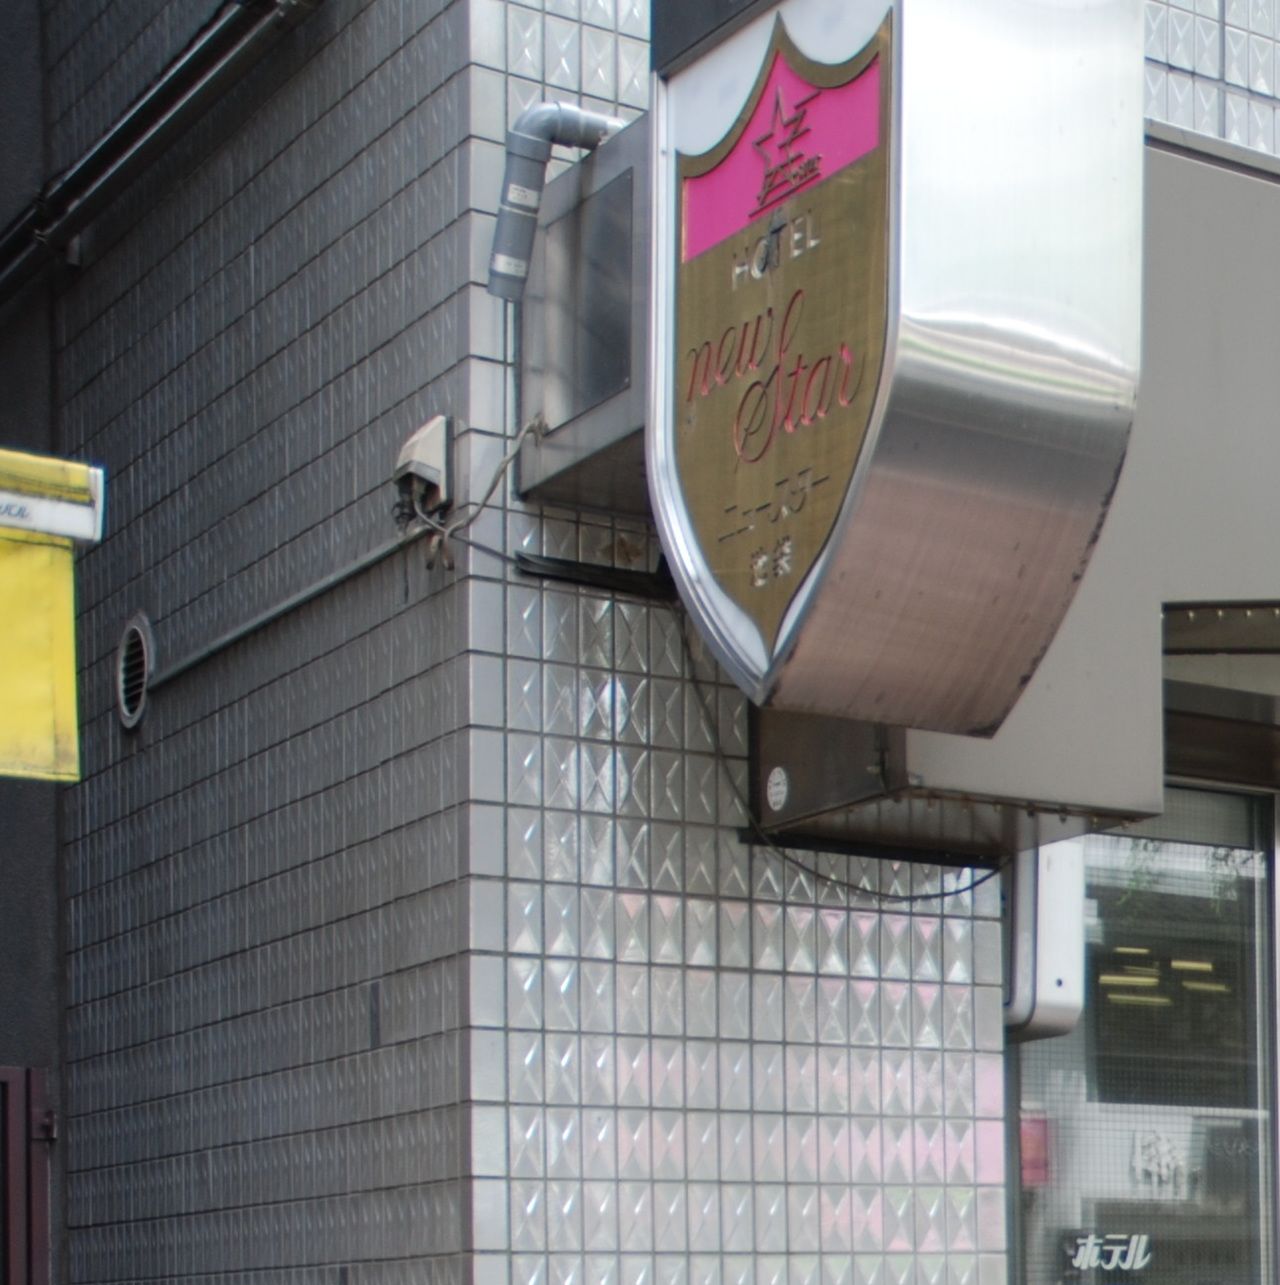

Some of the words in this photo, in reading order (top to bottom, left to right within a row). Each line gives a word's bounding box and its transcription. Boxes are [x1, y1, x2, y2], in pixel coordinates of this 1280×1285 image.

[731, 207, 820, 291] HOTEL
[1072, 1234, 1151, 1270] ホテル
